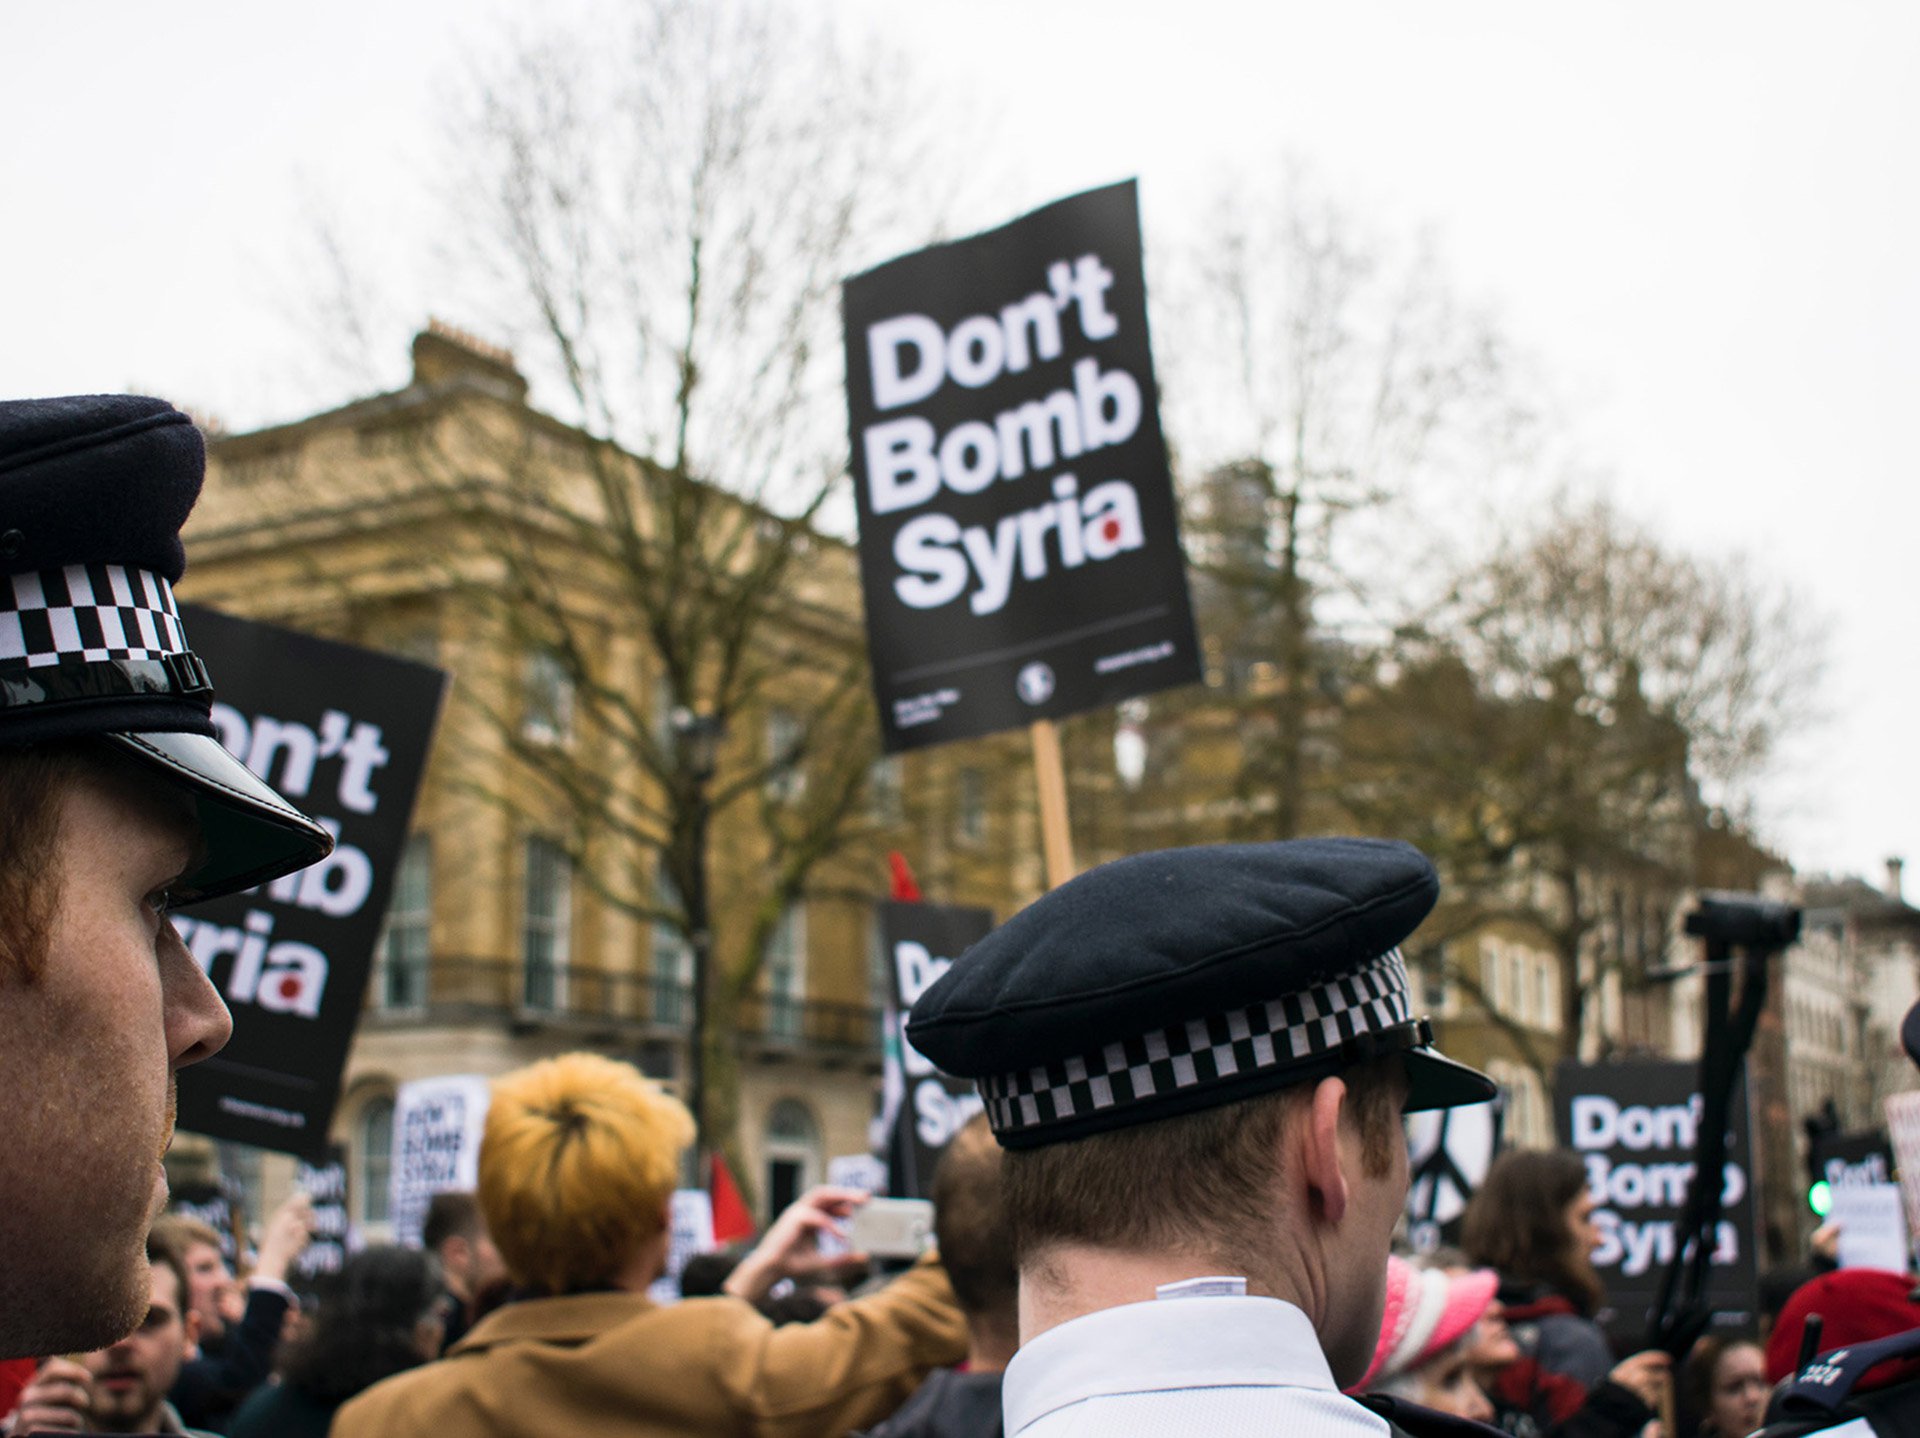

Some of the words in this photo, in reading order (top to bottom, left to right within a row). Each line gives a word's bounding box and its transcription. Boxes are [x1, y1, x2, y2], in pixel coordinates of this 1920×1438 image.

[866, 253, 1118, 411] Don't
[863, 357, 1143, 515] Bomb
[892, 474, 1145, 616] Syria
[211, 702, 390, 815] on't
[171, 910, 329, 1020] ria
[1571, 1092, 1705, 1150] Don'
